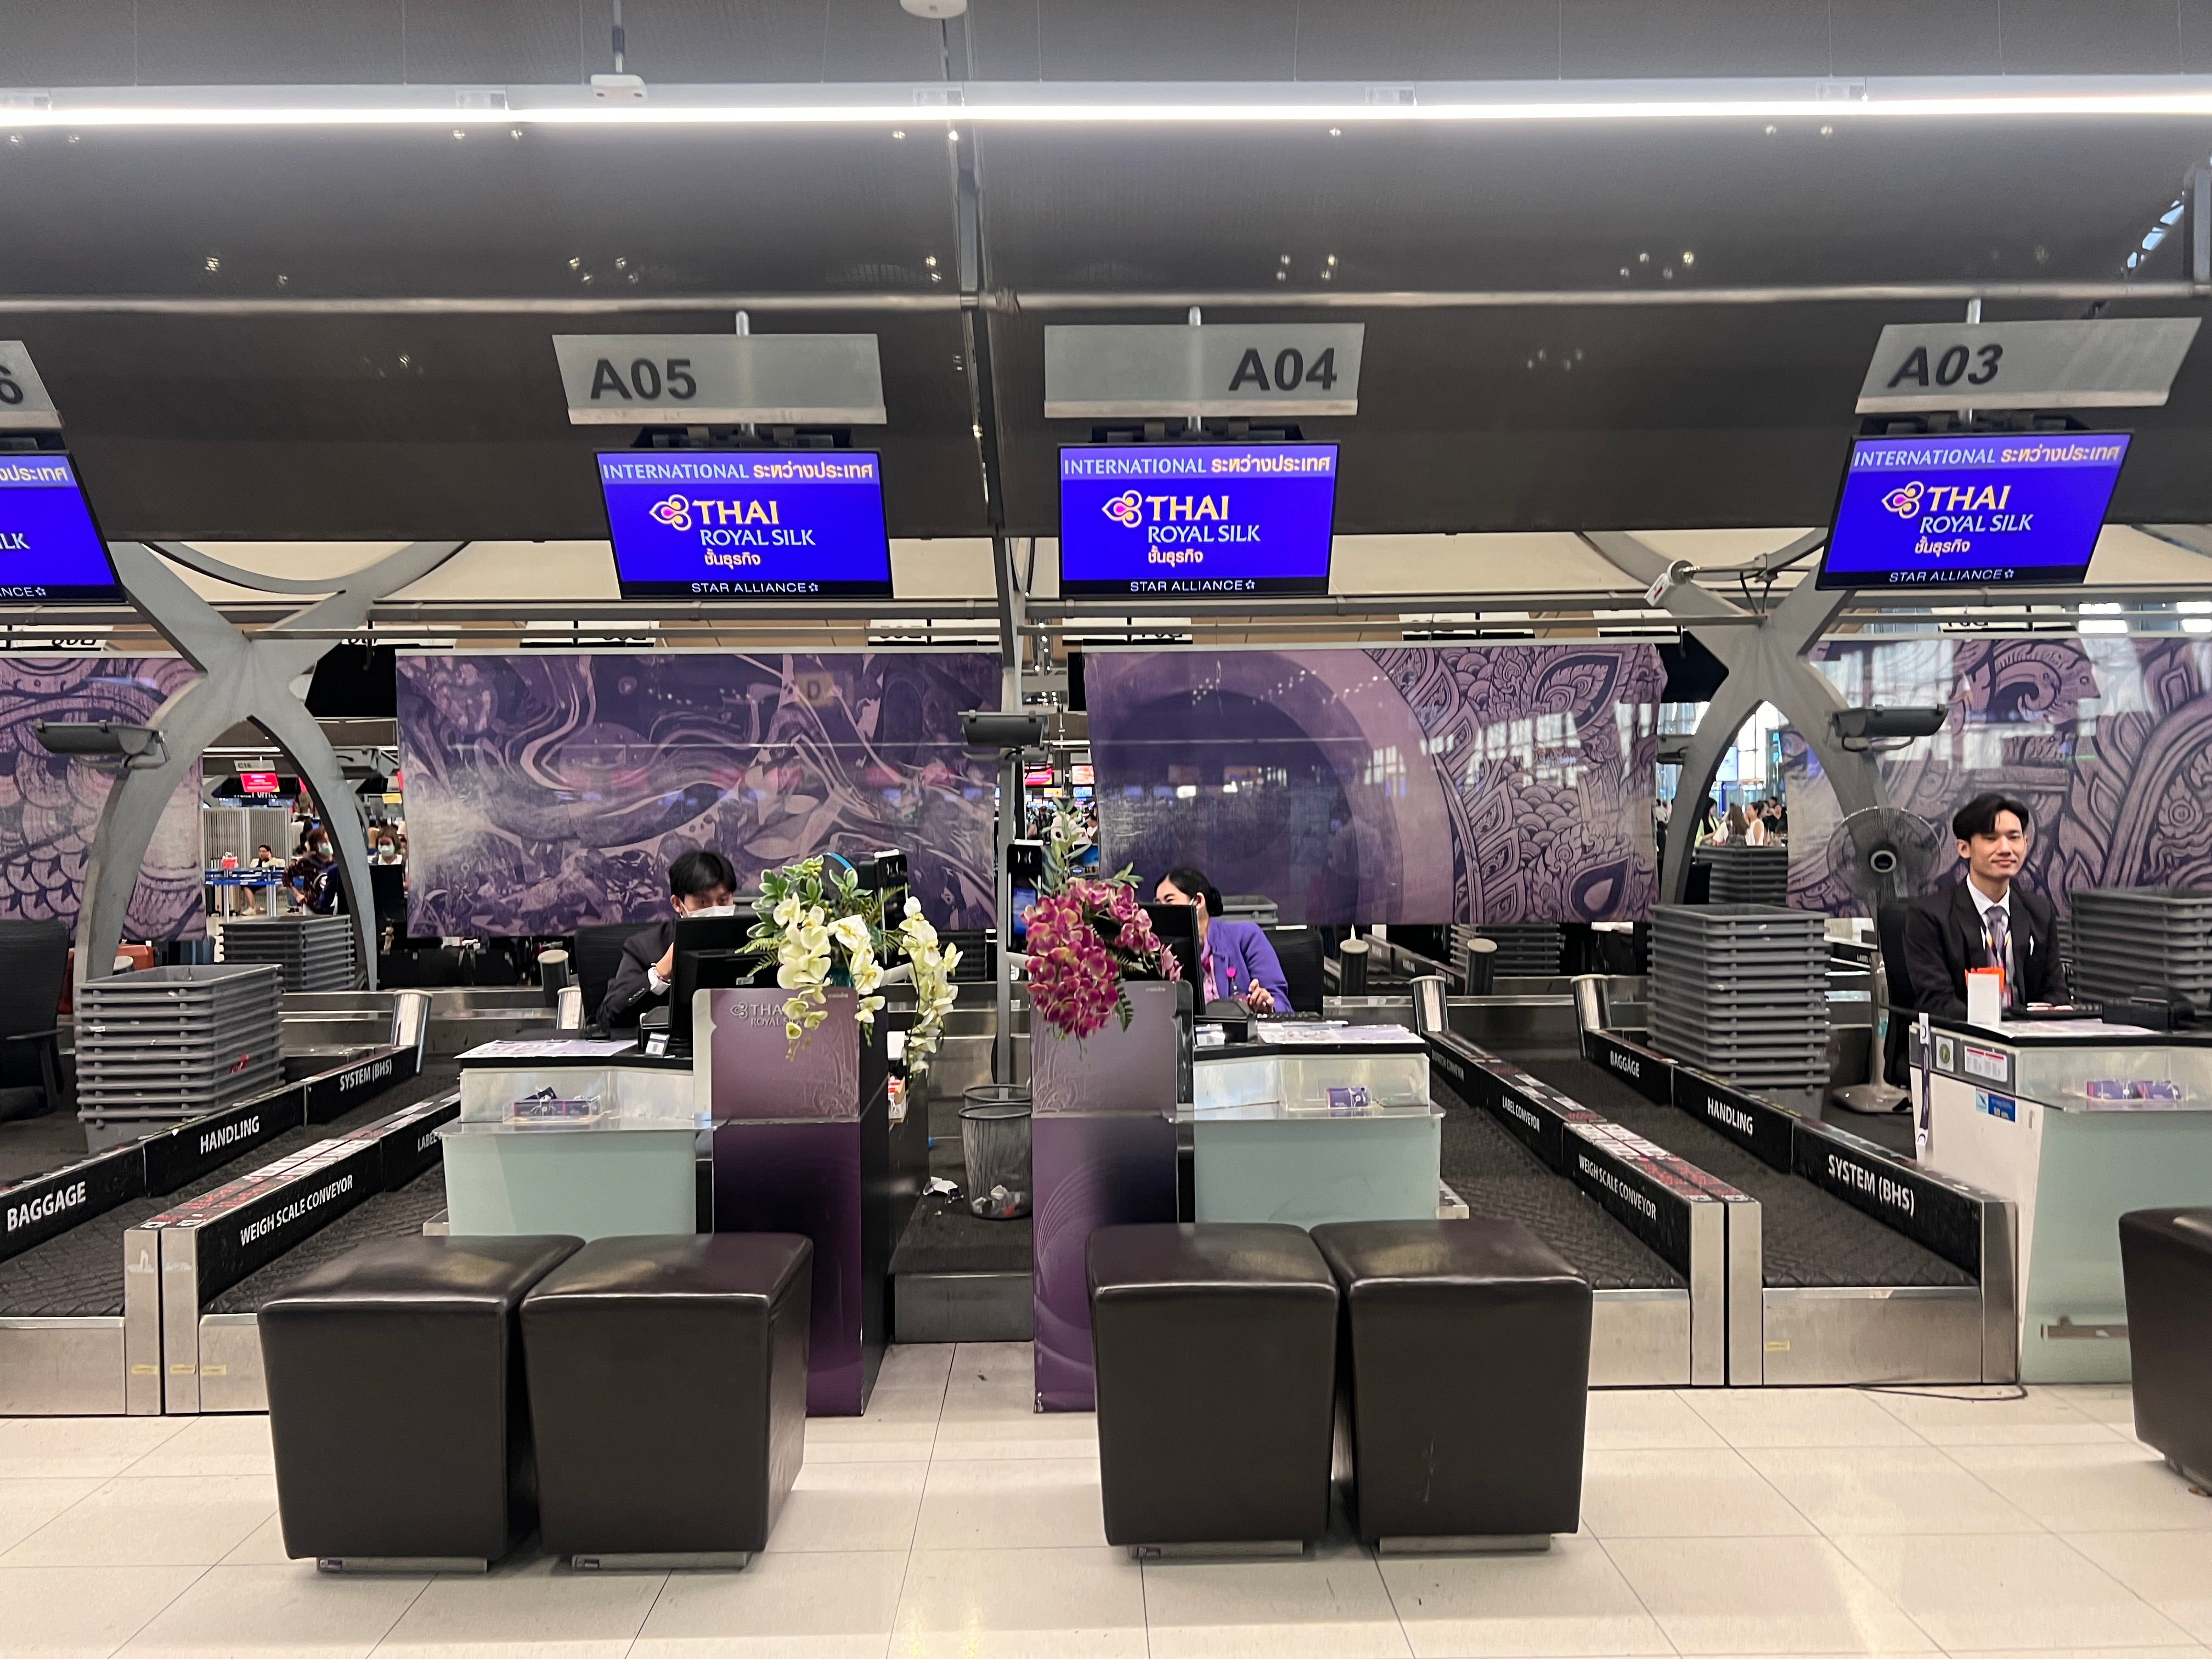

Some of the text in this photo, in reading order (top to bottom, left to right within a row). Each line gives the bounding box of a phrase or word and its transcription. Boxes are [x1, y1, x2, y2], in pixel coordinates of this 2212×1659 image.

[1228, 347, 1338, 391] A04
[1888, 343, 2003, 388] A03
[590, 358, 697, 401] A05
[1064, 454, 1330, 475] INTERNATIONAL ระหว่างประเทศ
[1854, 443, 2120, 467] INTERNATIONAL ระหว่างประเทศ
[603, 461, 873, 480] INTERNATIONAL ระหว่างประเทศ
[1146, 495, 1229, 521] THAI
[1926, 485, 2011, 511] THAI
[692, 500, 779, 525] THAI
[1920, 513, 2034, 534] ROYAL SILK
[700, 529, 816, 546] ROYAL SILK
[1148, 525, 1261, 543] ROYAL SILK
[704, 548, 761, 569] ชั้นธุรกิจ
[1148, 544, 1203, 568] ชั้นธุรกิจ
[1915, 535, 1970, 558] ชั้นธุรกิจ
[692, 583, 806, 593] STAR ALLIANCE
[1130, 580, 1243, 592] STAR ALLIANCE
[1889, 569, 2003, 583] STAR ALLIANCE
[749, 1004, 783, 1015] THA
[751, 1017, 782, 1027] ROYAL
[339, 1059, 392, 1092] SYSTEM (BHS)
[1610, 1051, 1640, 1078] BAGGAGE
[1502, 1095, 1540, 1133] LABEL CONVEYOR
[1707, 1097, 1753, 1136] HANDLING
[200, 1116, 260, 1155] HANDLING
[417, 1131, 437, 1152] LABEL
[1579, 1153, 1598, 1181] WEIGH
[1599, 1170, 1618, 1194] SCALE
[1619, 1181, 1656, 1220] CONVEYOR
[1828, 1155, 1915, 1218] SYSTEM (BHS)
[7, 1181, 87, 1232] BAGGAGE
[240, 1216, 274, 1247] WEIGH
[276, 1199, 306, 1228] SCALE
[307, 1175, 353, 1210] CONVEYOR
